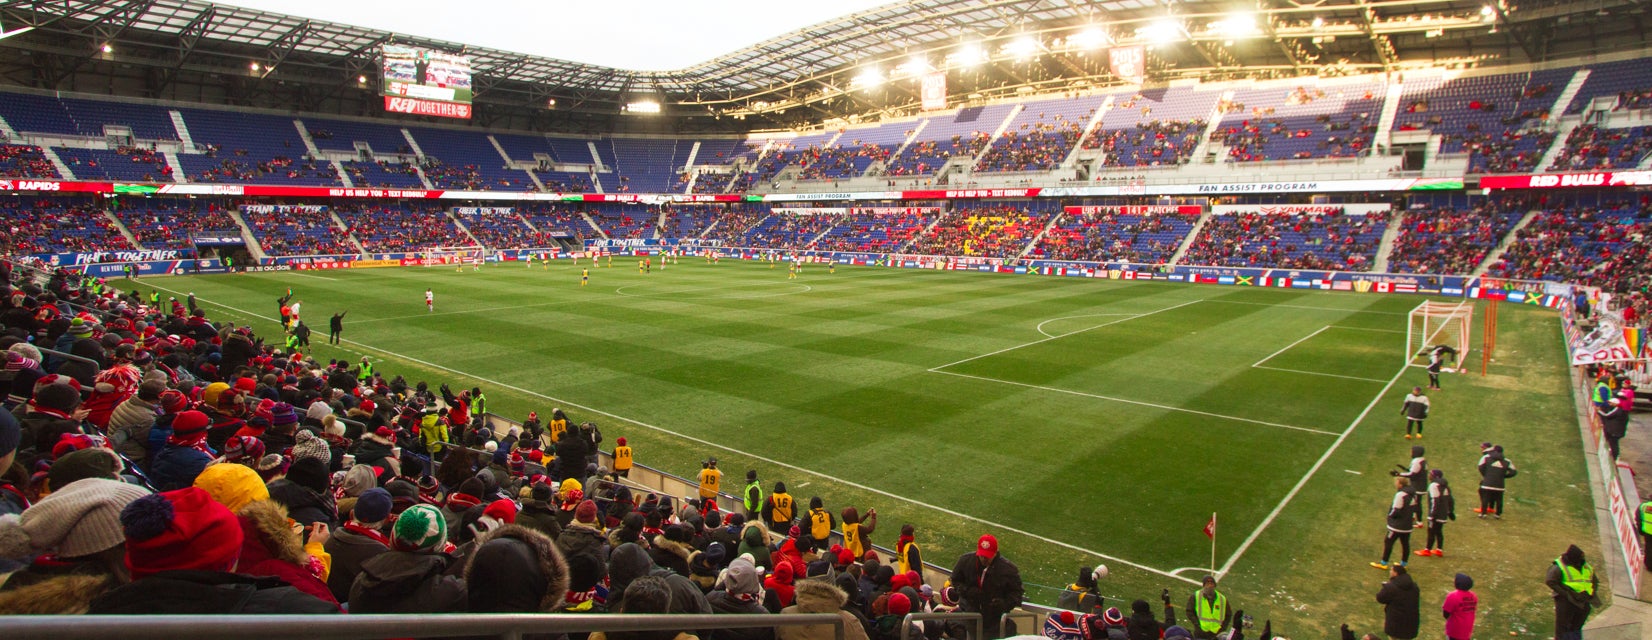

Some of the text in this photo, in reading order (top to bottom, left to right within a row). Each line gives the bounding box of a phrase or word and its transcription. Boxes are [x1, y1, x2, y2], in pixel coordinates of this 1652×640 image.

[1111, 48, 1141, 66] 2015
[1529, 173, 1605, 187] RED BULLS
[18, 181, 60, 191] RAPIDS
[329, 189, 344, 197] HELP
[345, 189, 354, 197] US
[355, 189, 369, 197] HELP
[370, 189, 383, 197] YOU
[388, 190, 401, 198] TEXT
[946, 190, 957, 198] HELP
[958, 190, 965, 198] US
[992, 189, 1003, 197] TEXT
[246, 205, 275, 214] STAND
[1082, 206, 1095, 214] LUIS
[1127, 206, 1140, 214] 141
[76, 250, 177, 265] FIGHT TOGETHER
[554, 423, 563, 431] 10
[620, 449, 630, 458] 14
[705, 475, 716, 485] 19
[776, 497, 788, 508] 16
[818, 512, 825, 523] 2
